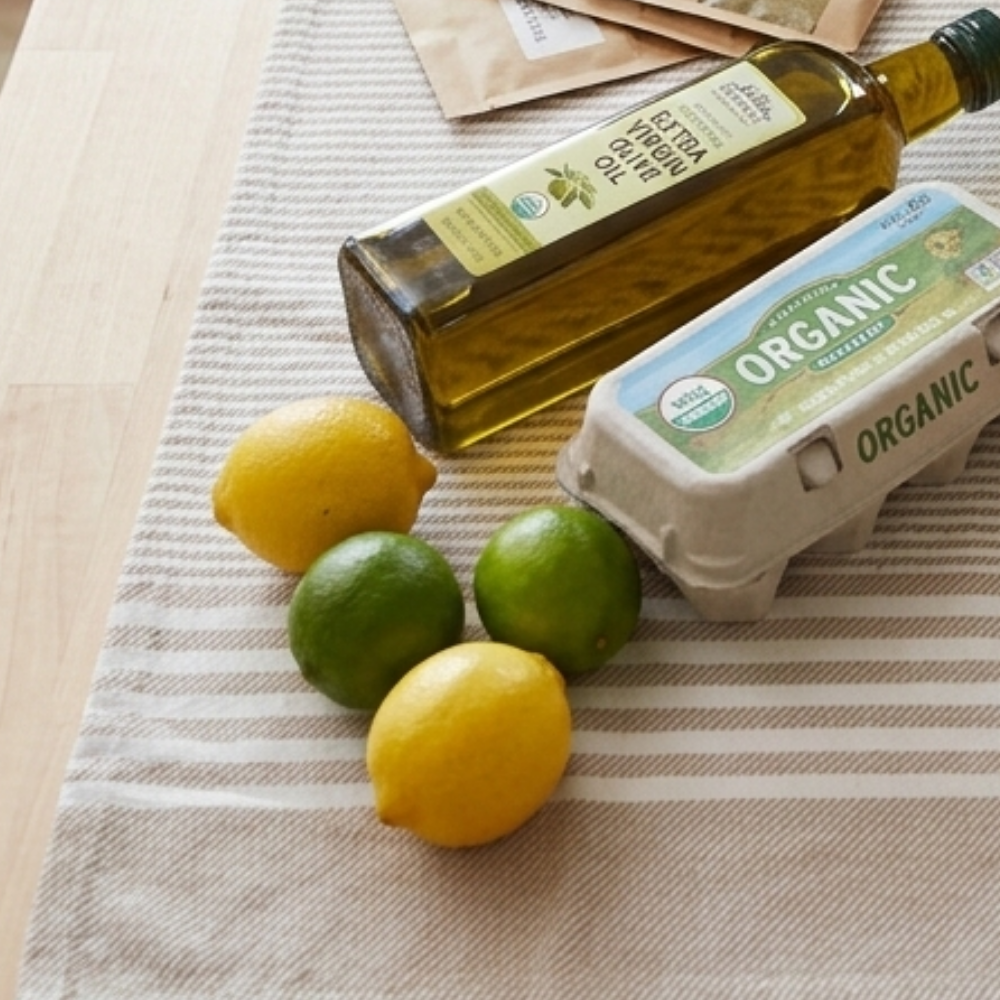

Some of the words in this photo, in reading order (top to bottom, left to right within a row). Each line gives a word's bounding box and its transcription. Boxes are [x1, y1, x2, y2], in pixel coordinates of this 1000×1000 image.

[594, 155, 627, 185] OIL
[734, 263, 917, 385] ORGANIC
[856, 358, 980, 463] ORGANIC
